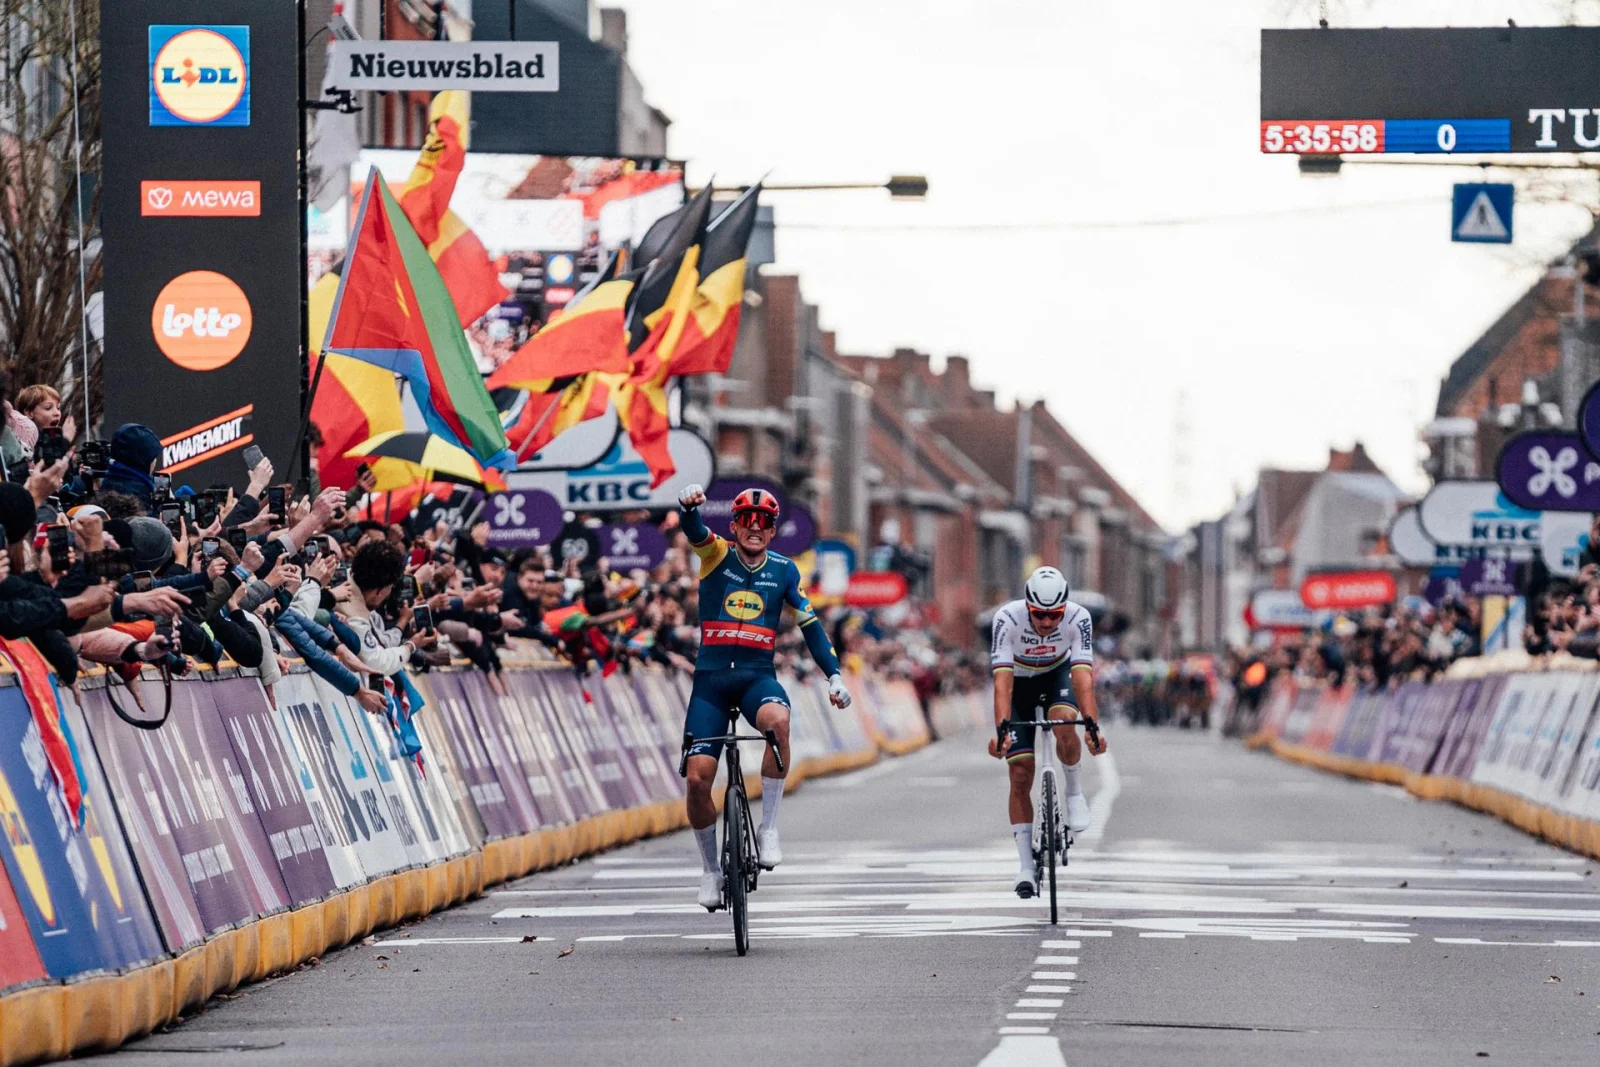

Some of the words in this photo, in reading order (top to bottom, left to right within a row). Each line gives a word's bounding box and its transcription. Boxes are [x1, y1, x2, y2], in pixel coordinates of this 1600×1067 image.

[349, 52, 545, 79] Nieuwsblad
[1264, 124, 1378, 152] 5:35:58
[1437, 124, 1456, 151] 0
[162, 303, 242, 338] lotto
[162, 419, 242, 468] KWAREMONT
[568, 480, 651, 503] KBC
[705, 629, 772, 644] TREK
